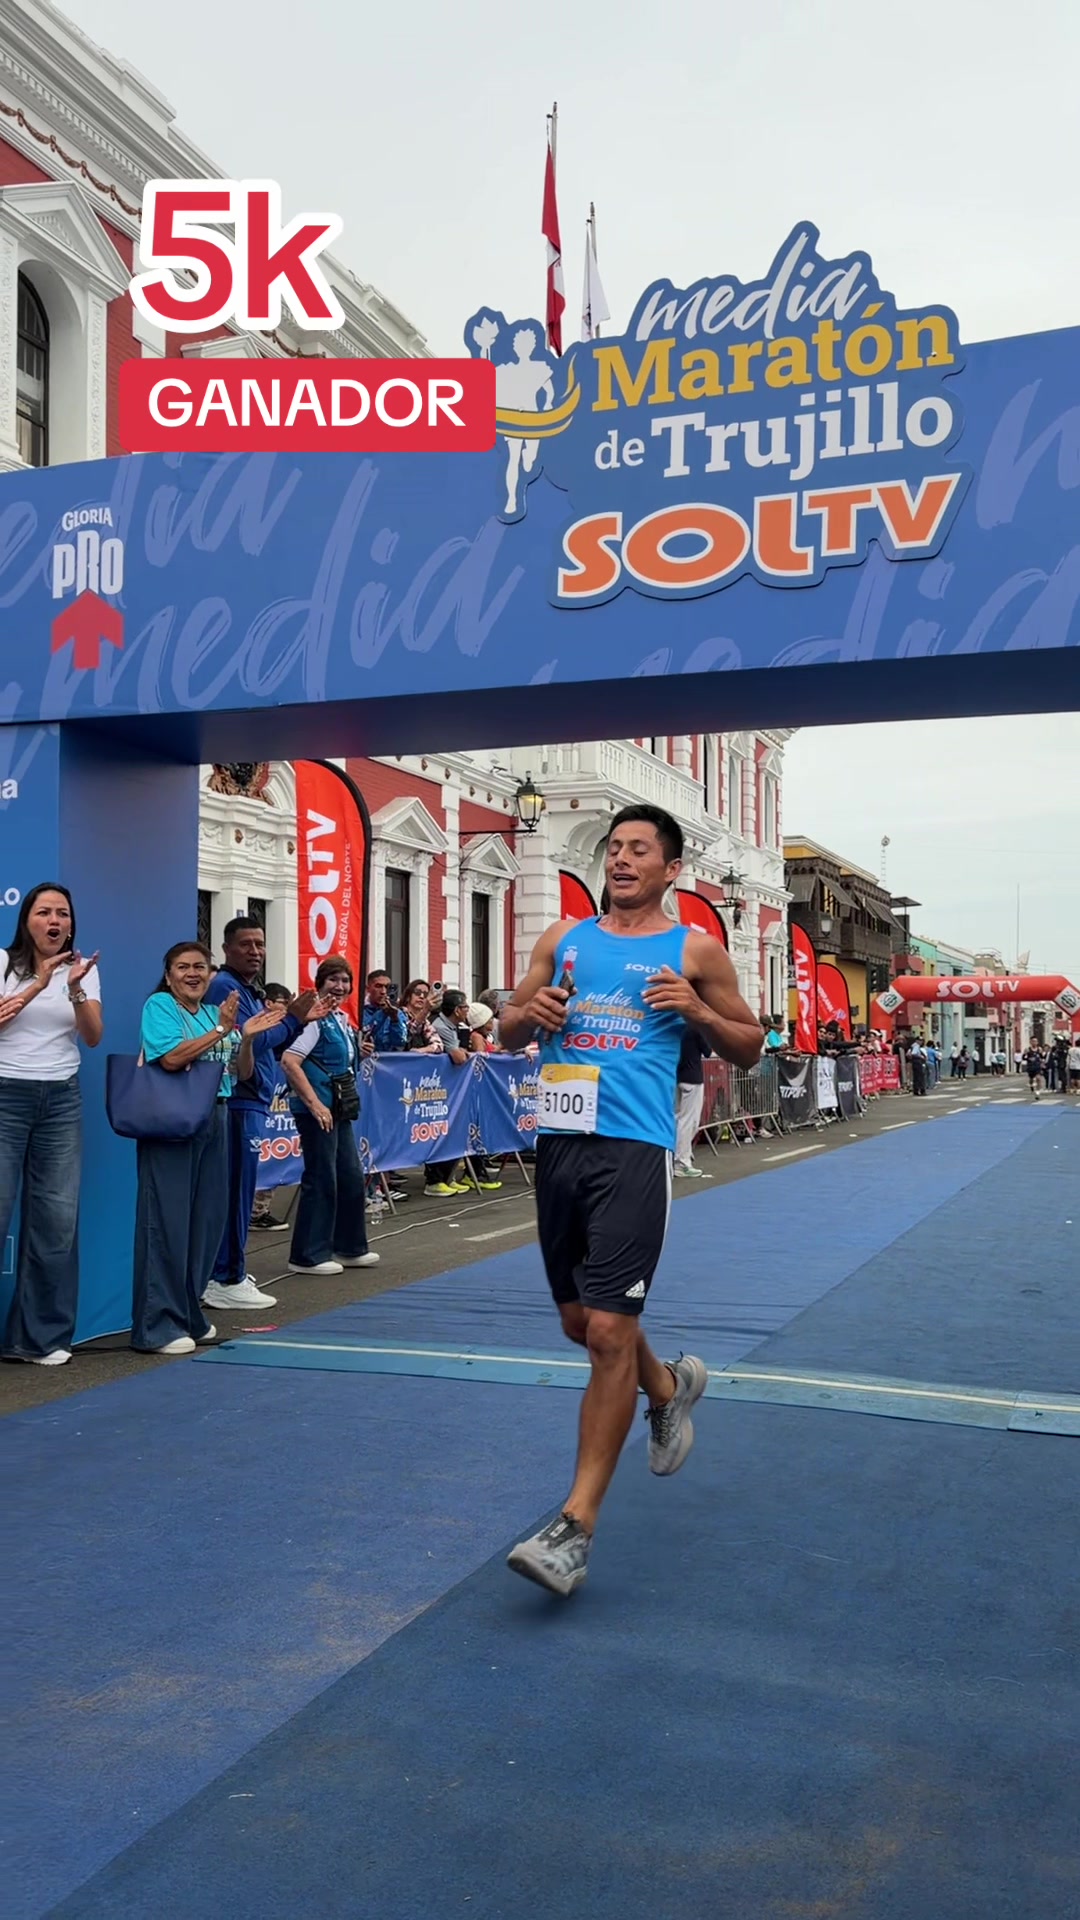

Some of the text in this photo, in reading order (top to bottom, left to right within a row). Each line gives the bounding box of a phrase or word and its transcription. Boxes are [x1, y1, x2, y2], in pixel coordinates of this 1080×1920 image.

[635, 231, 868, 341] media
[591, 302, 954, 413] Maratón
[594, 430, 646, 471] de
[651, 382, 954, 480] Trujillo
[61, 507, 114, 532] GLORIA
[557, 472, 963, 599] SOLTV
[342, 885, 352, 908] DEL
[582, 1014, 642, 1033] Trujillo
[562, 1032, 638, 1052] SOLTV
[544, 1091, 584, 1115] 5100
[259, 1134, 303, 1162] SOL
